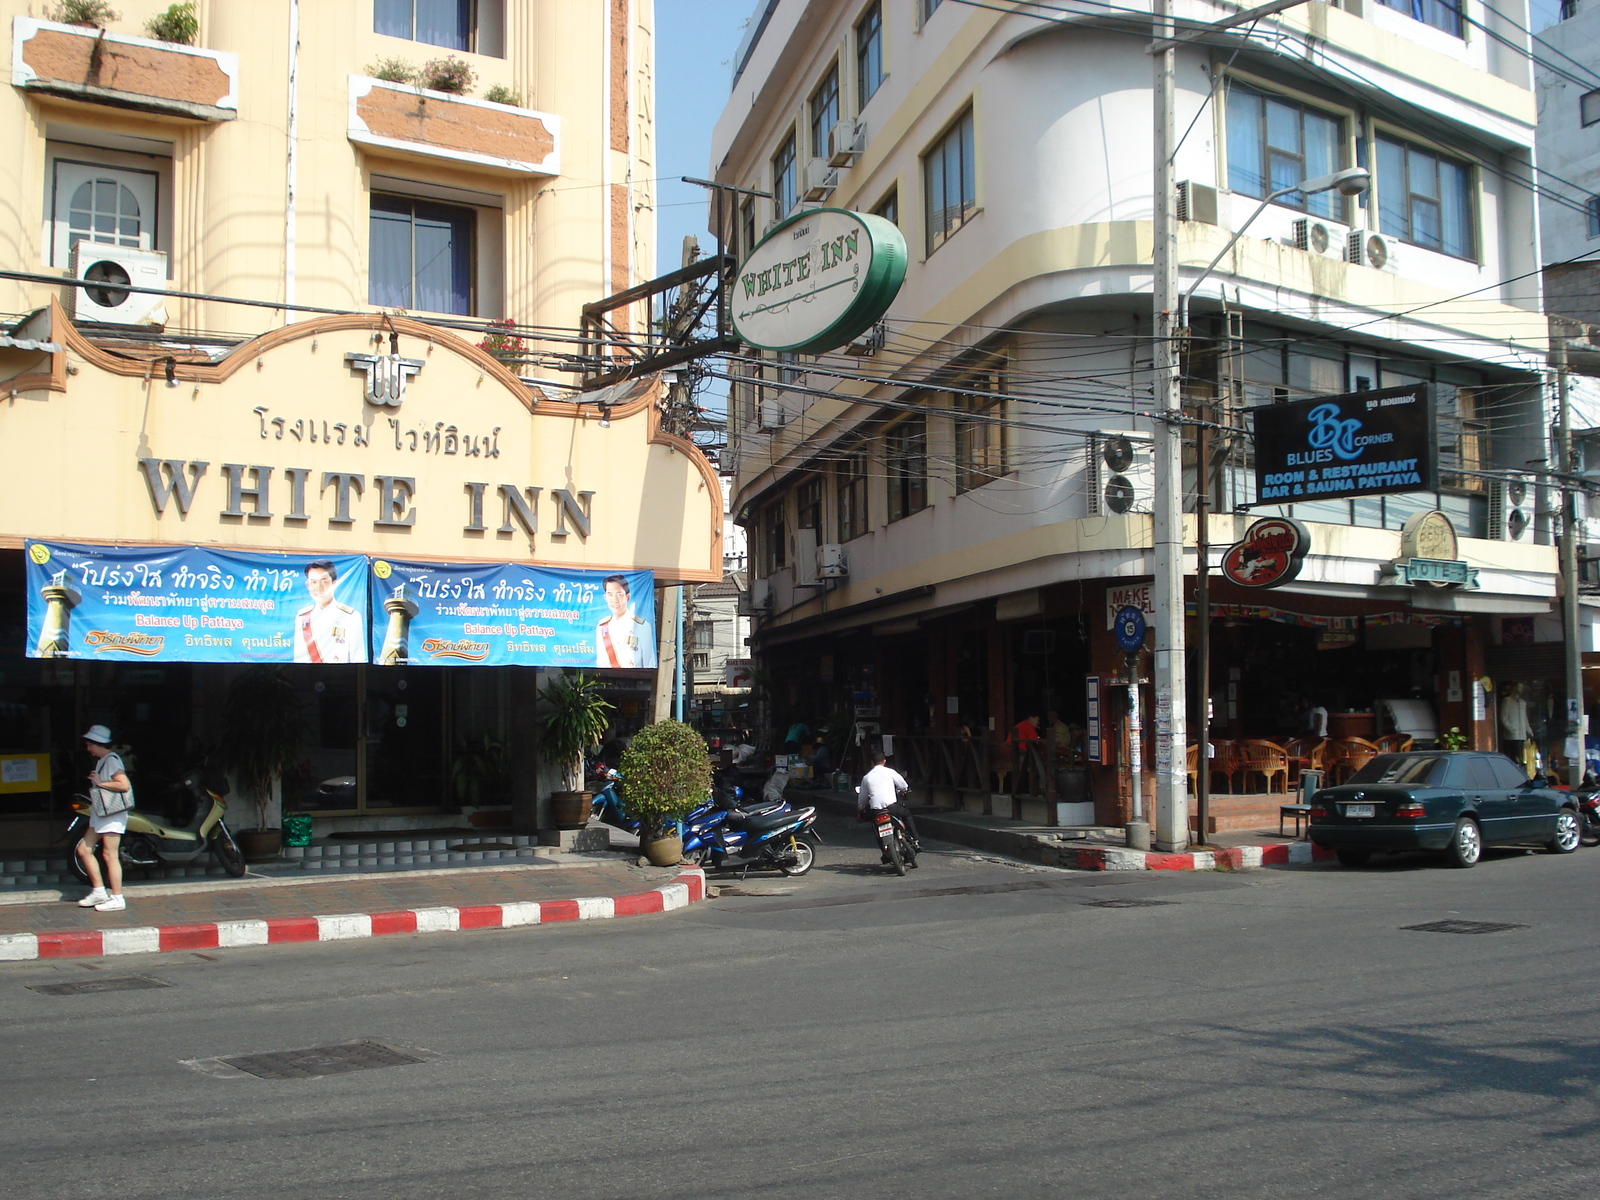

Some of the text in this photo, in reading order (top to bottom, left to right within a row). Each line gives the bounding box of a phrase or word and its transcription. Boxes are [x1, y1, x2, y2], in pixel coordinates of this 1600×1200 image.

[741, 228, 859, 301] WHITE INN
[253, 405, 502, 459] โรงแรม ไวท์อินน์
[1354, 433, 1394, 447] CORNER
[1287, 449, 1334, 466] BLUES
[1264, 458, 1418, 486] ROOM & RESTAURANT
[1262, 472, 1421, 498] BAR & SAUNA PATTAYA
[138, 457, 597, 538] WHITE INN
[71, 561, 300, 592] "โปร่งใส ทำจริง ทำได้"
[409, 575, 599, 604] "โปร่งใส ทำจริง ทำได้"
[1113, 588, 1149, 604] MAKE
[135, 613, 244, 630] Balance Up Pattaya
[464, 623, 555, 638] Balance Up Pattaya
[1126, 624, 1134, 634] 15
[184, 632, 291, 650] อิทธิพล คุณปลื้ม
[506, 640, 595, 656] อิทธิพล คุณปลื้ม
